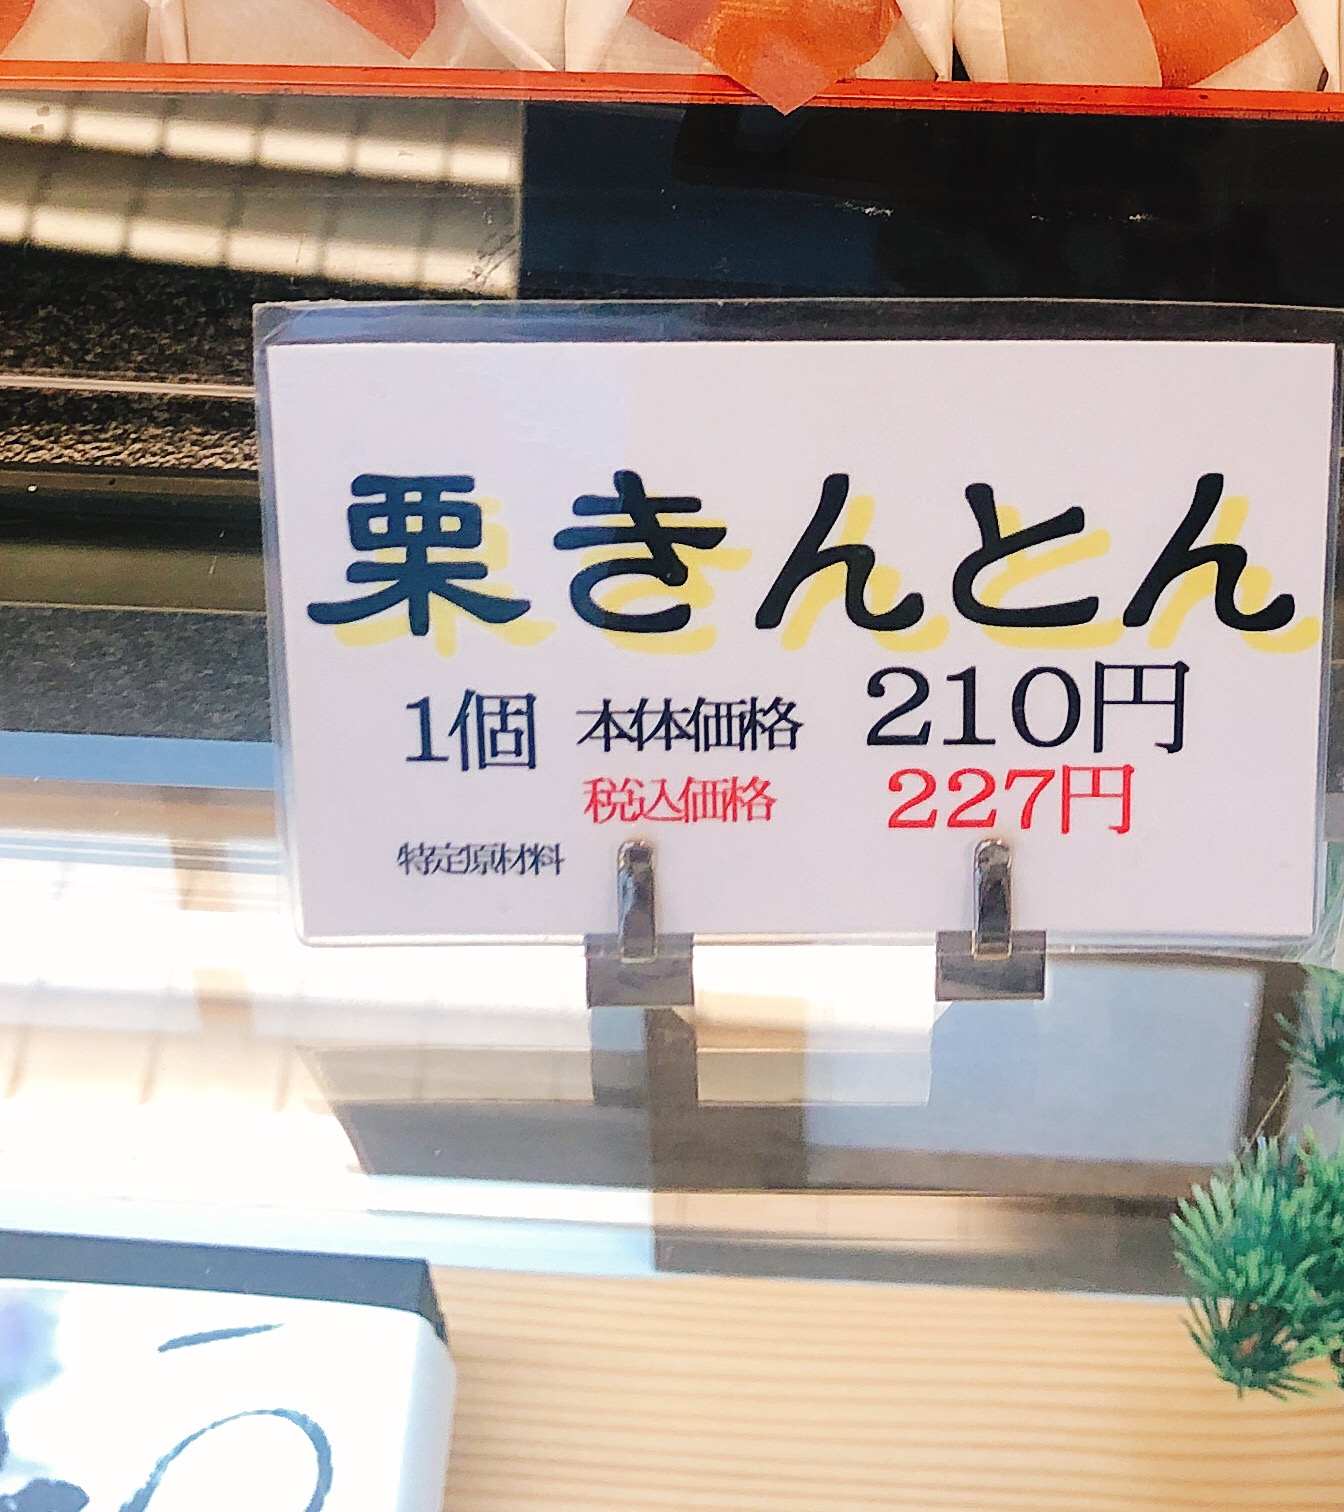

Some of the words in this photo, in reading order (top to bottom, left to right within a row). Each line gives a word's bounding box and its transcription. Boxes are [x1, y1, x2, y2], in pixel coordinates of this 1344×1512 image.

[307, 471, 1296, 637] 栗きんとん
[405, 689, 537, 772] 1個
[576, 697, 804, 753] 本体価格
[866, 661, 1191, 755] 210円
[582, 775, 778, 825] 税込価格
[887, 764, 1136, 835] 227円
[397, 842, 565, 875] 特定原材料
